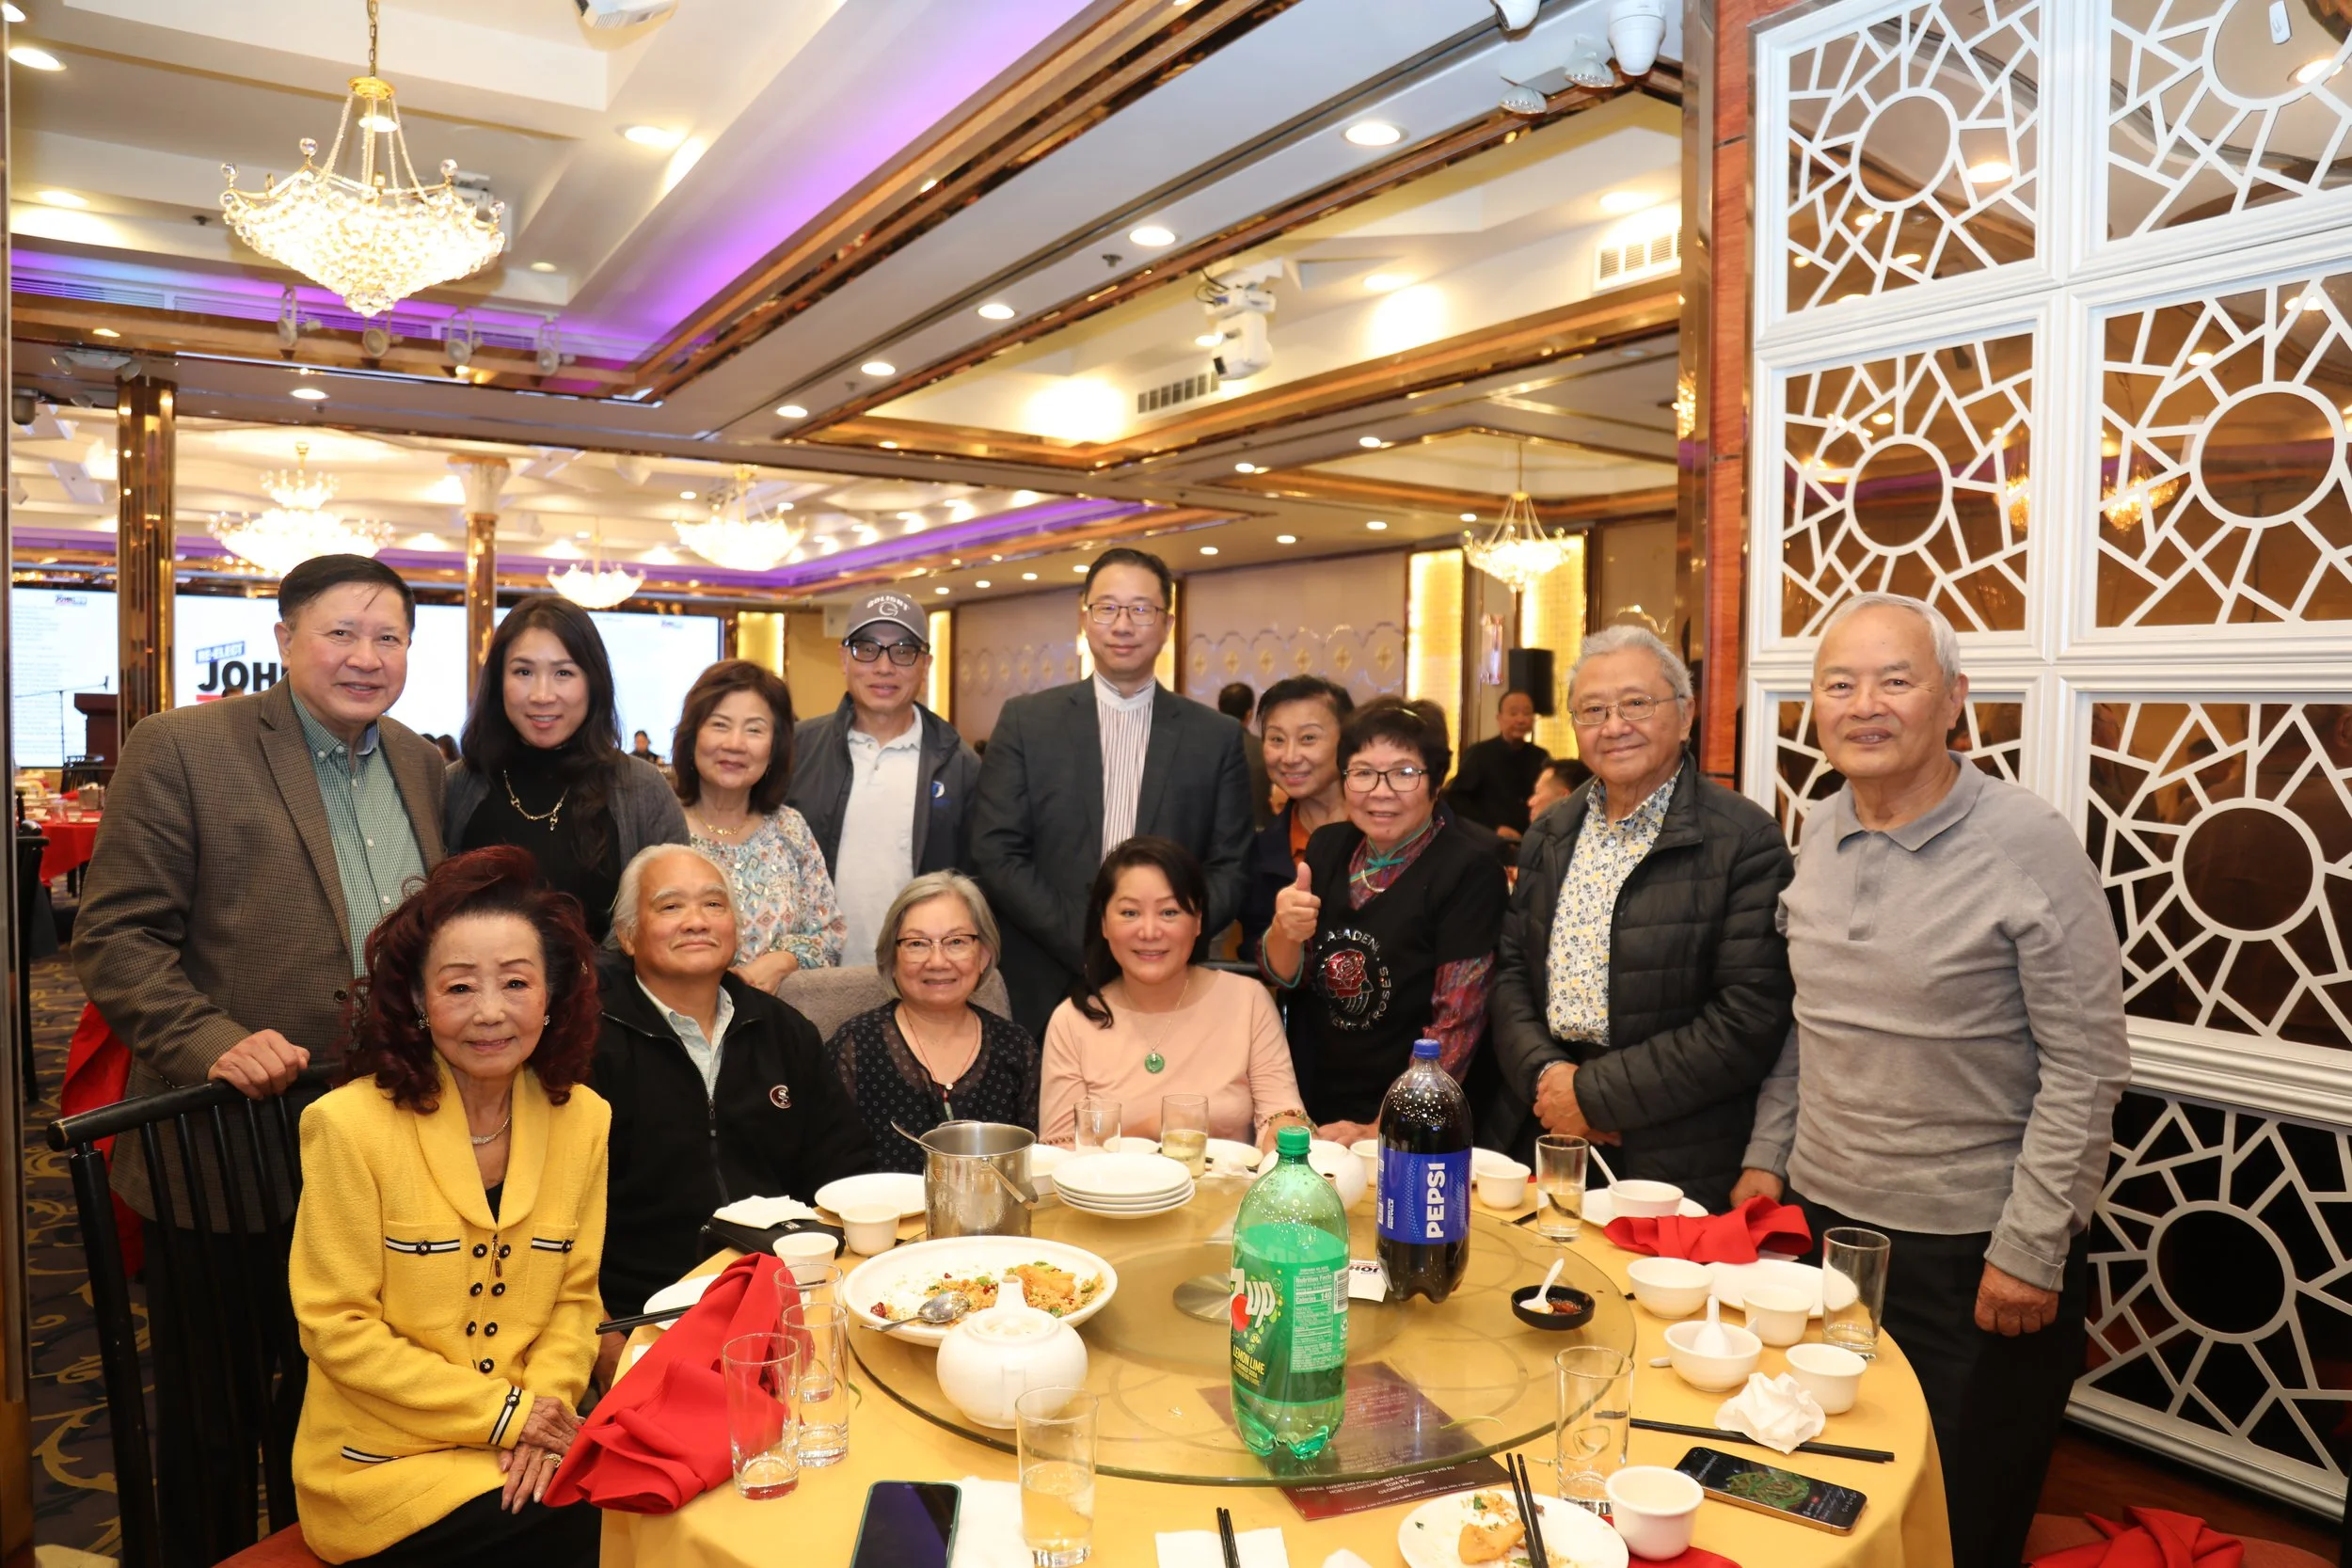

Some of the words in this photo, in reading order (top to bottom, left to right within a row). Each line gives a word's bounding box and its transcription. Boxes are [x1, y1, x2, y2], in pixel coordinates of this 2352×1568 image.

[198, 660, 288, 692] JOH
[1426, 1163, 1446, 1238] PEPSI
[1321, 1291, 1332, 1300] 140
[1233, 1345, 1250, 1367] LEMON
[1250, 1357, 1265, 1375] LIME
